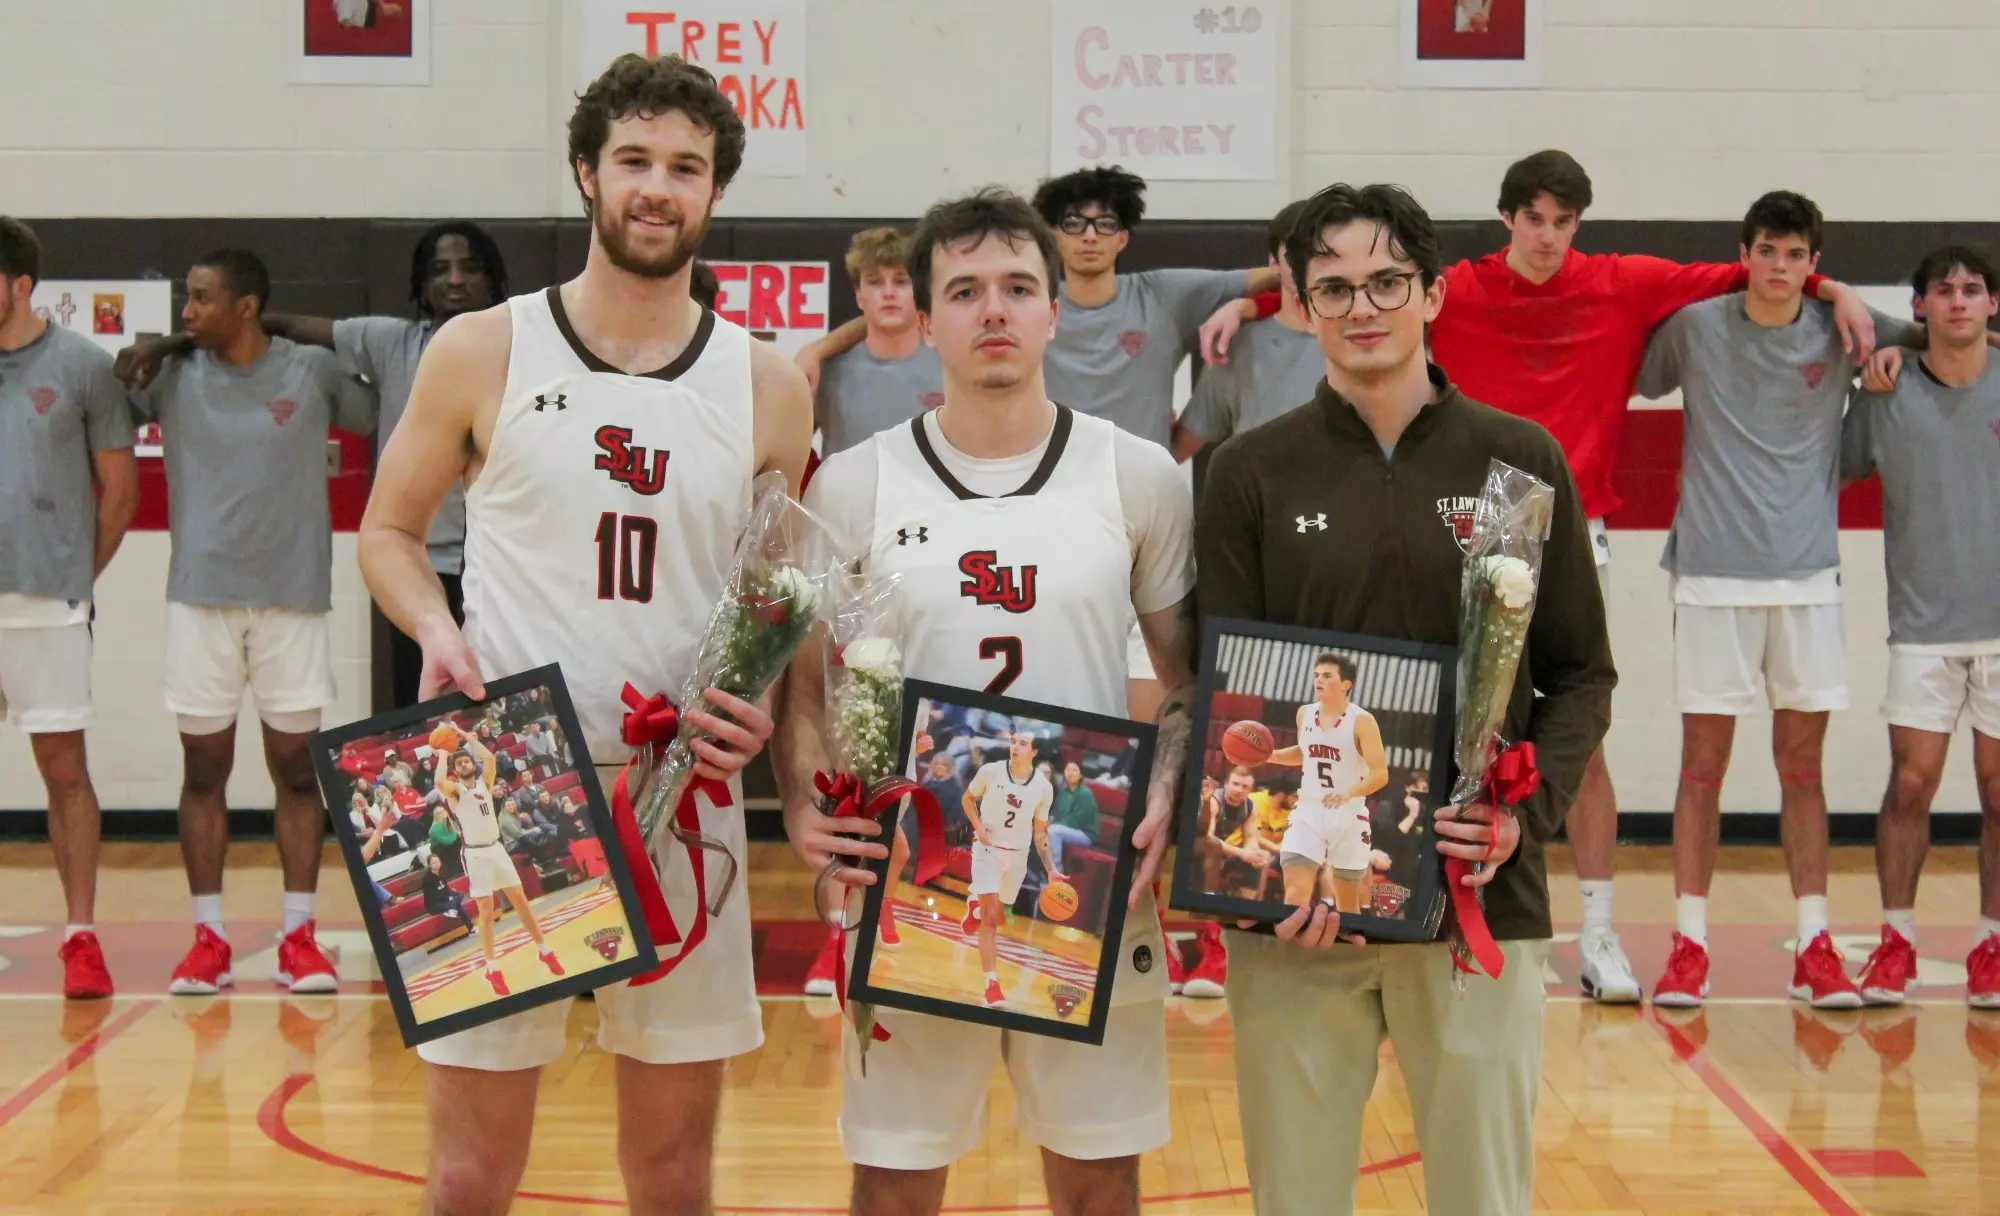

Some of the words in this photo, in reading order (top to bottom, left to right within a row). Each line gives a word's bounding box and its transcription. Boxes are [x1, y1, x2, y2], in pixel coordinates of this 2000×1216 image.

[626, 12, 777, 65] TREY
[1193, 7, 1262, 34] #10
[1074, 26, 1238, 90] CARTER
[1076, 104, 1236, 159] STOREY
[594, 425, 670, 495] SLU
[594, 511, 658, 604] 10
[958, 550, 1038, 614] SLU
[979, 635, 1023, 697] 2
[1317, 761, 1335, 788] 5
[480, 802, 490, 817] 10
[1004, 810, 1016, 829] 2
